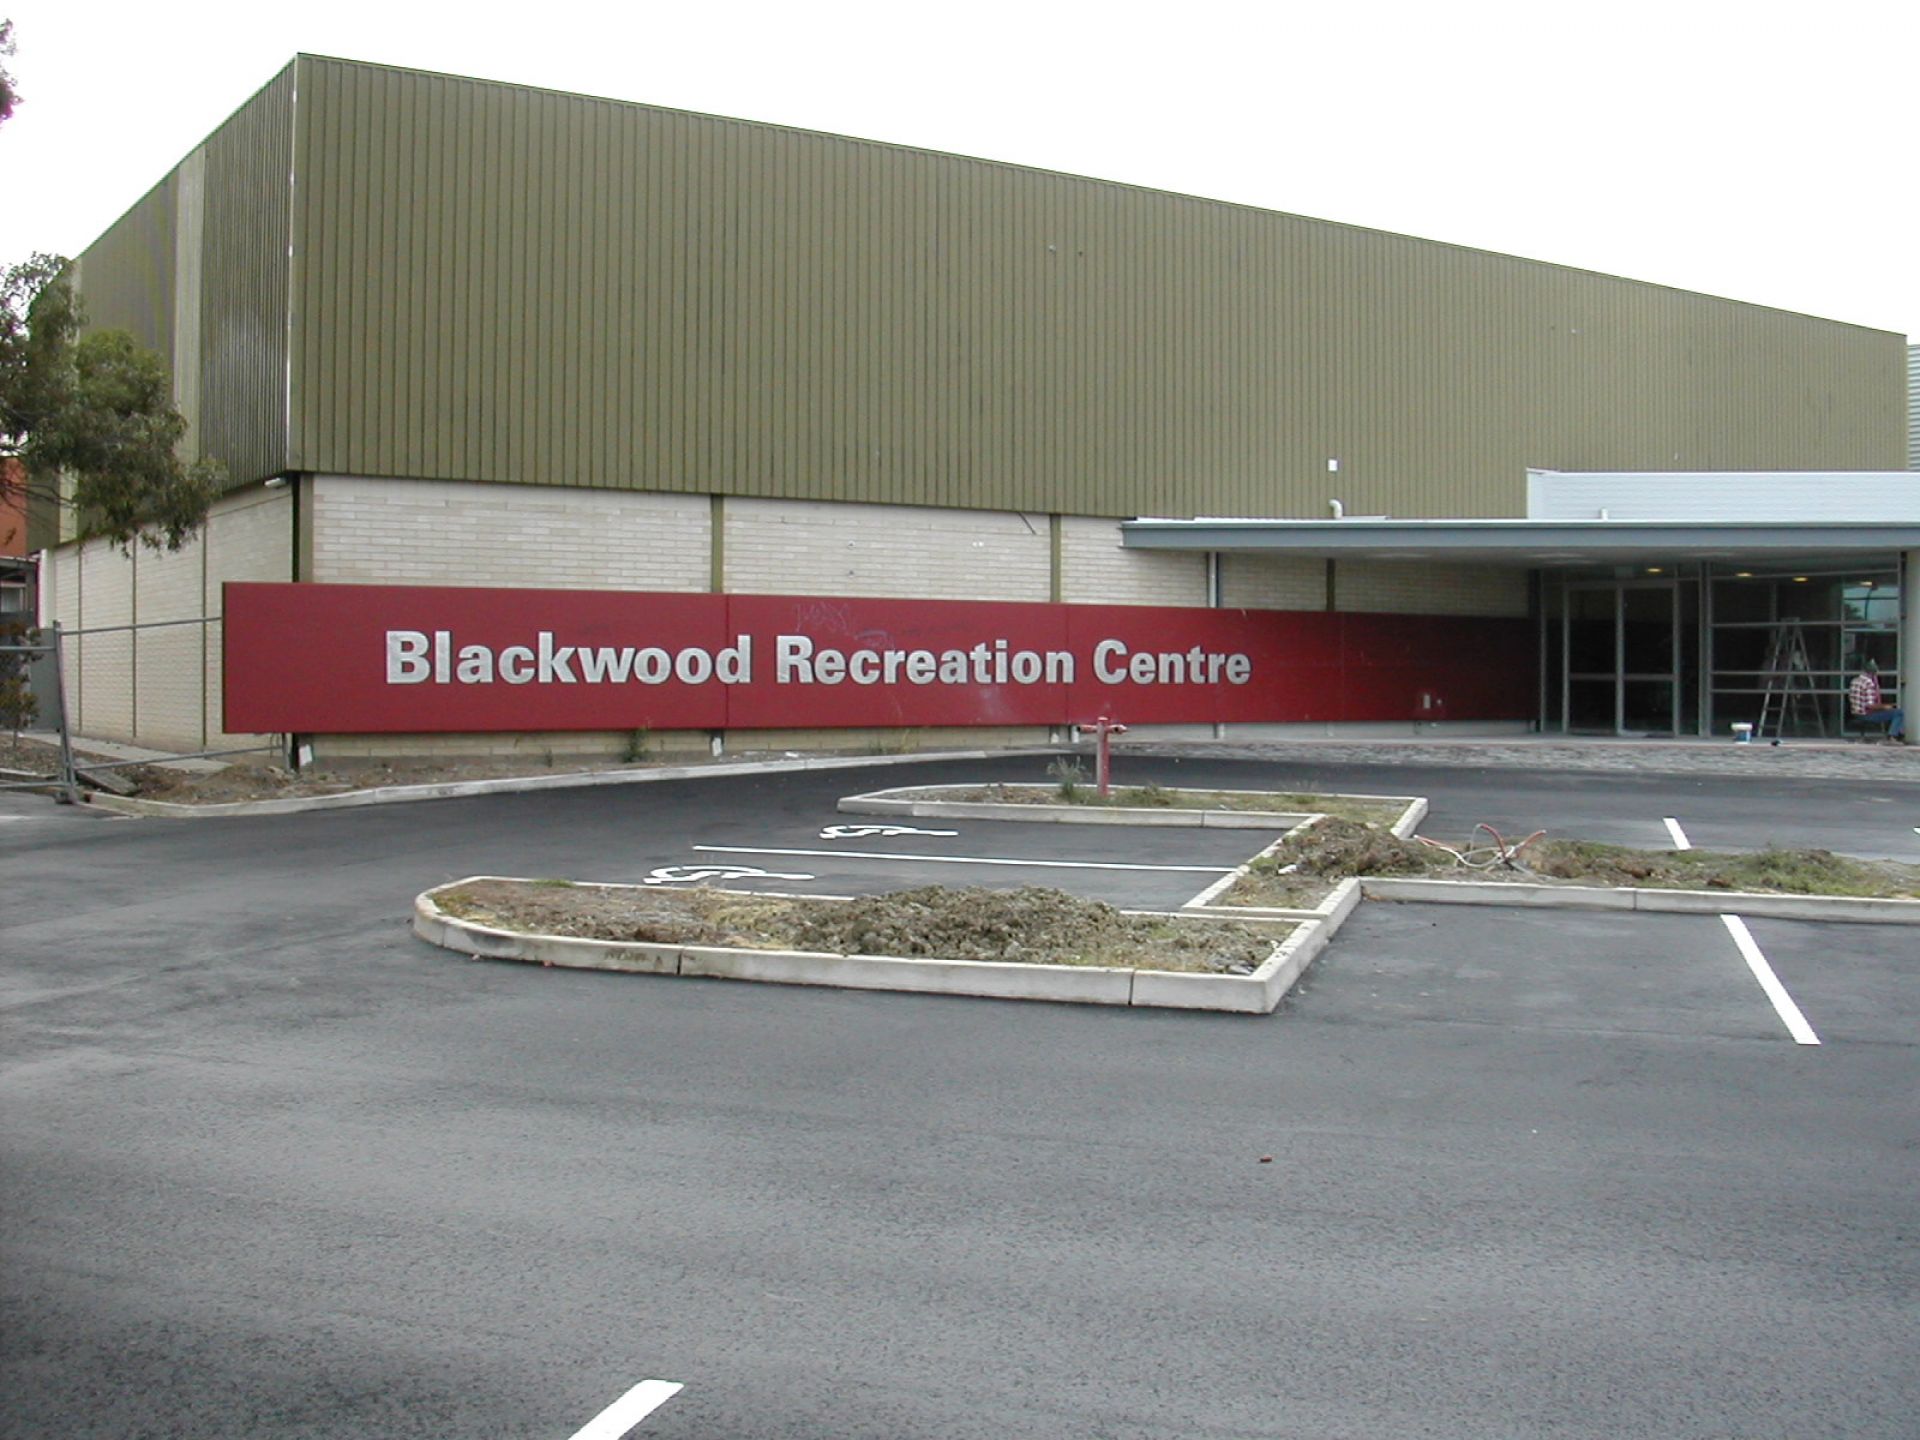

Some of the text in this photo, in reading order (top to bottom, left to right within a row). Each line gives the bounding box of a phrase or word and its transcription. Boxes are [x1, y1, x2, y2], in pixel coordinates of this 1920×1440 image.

[385, 630, 1252, 686] Blackwood Recreation Centre
